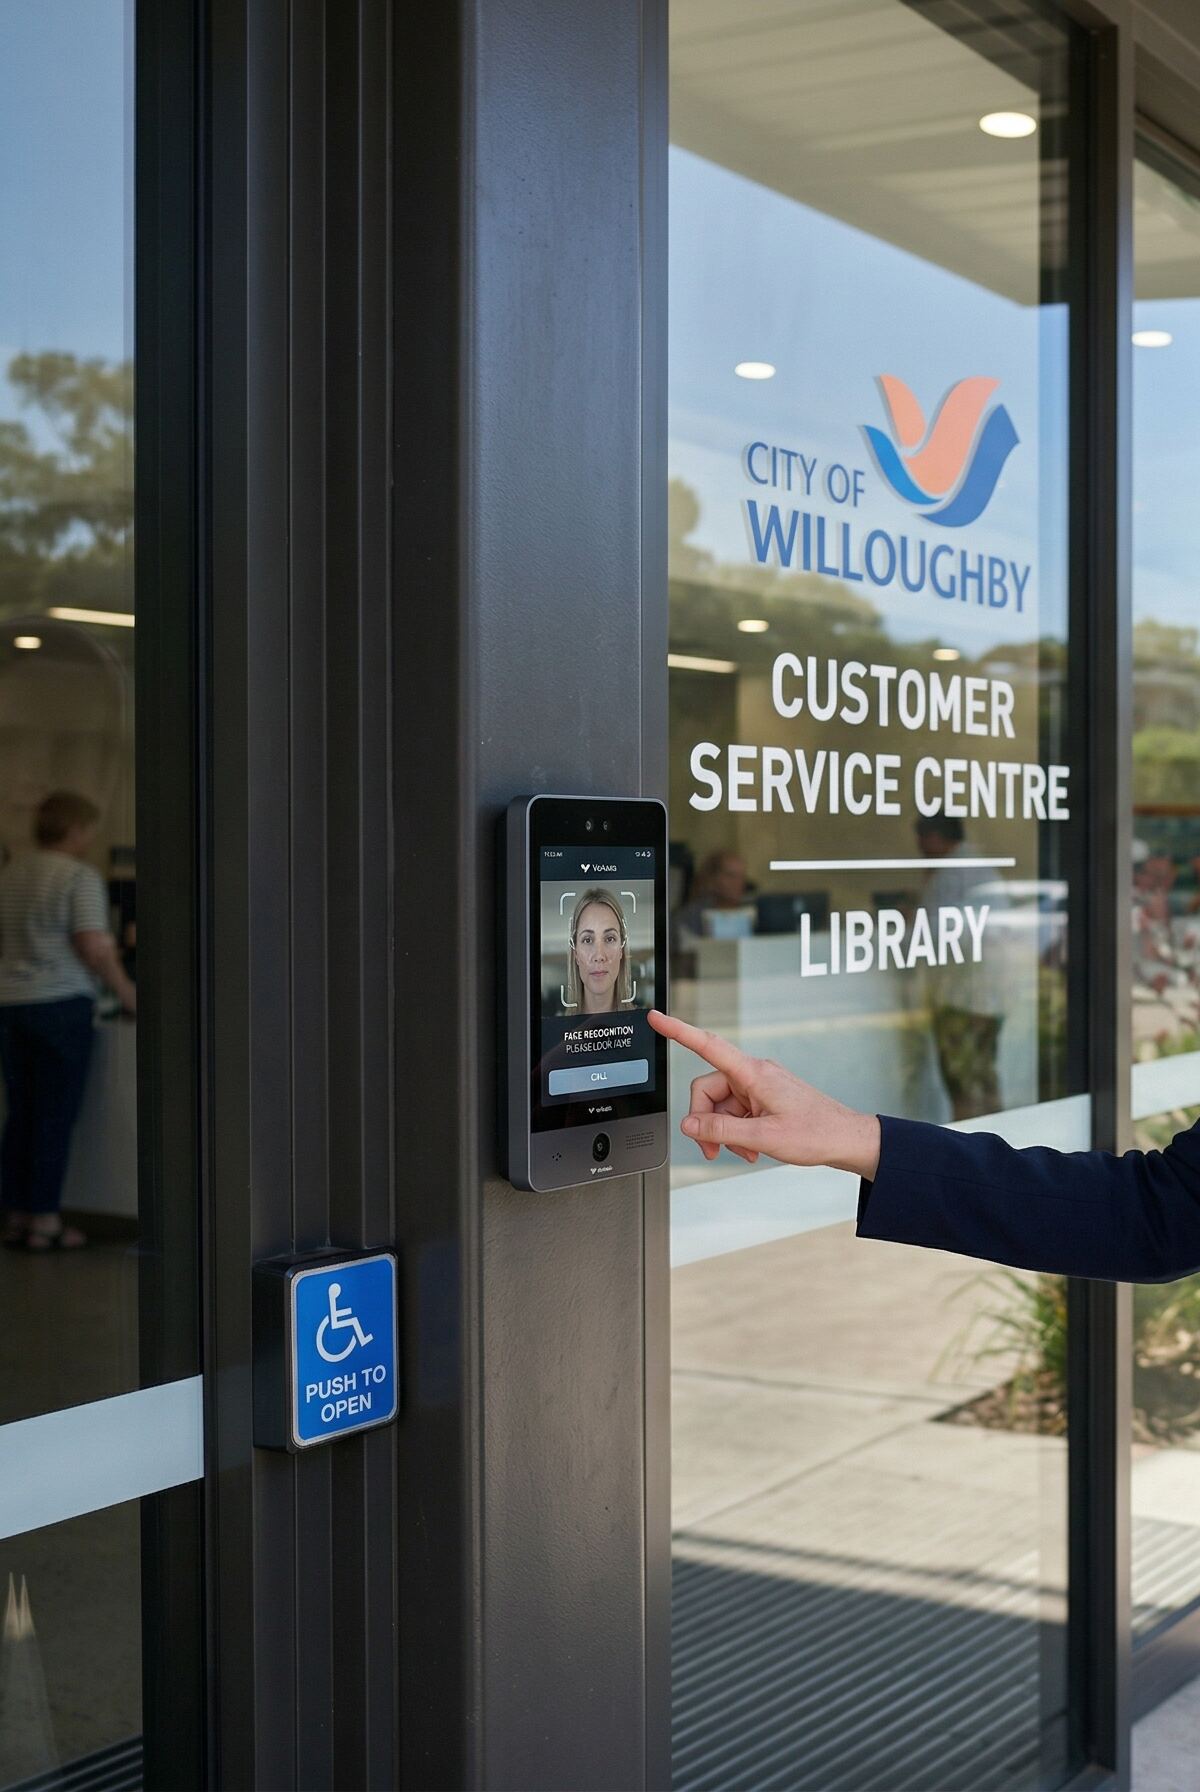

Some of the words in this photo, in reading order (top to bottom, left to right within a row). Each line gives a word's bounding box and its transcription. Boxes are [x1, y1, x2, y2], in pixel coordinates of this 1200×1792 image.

[747, 442, 817, 495] CITY
[828, 464, 866, 508] OF
[747, 499, 1031, 612] WILLOUGHBY
[772, 652, 1016, 739] CUSTOMER
[689, 742, 902, 817] SERVICE
[914, 756, 1071, 821] CENTRE
[800, 905, 991, 978] LIBRARY
[583, 1025, 634, 1039] RECOGNITION
[306, 1371, 357, 1403] PUSH
[361, 1365, 386, 1386] TO
[320, 1392, 372, 1423] OPEN
